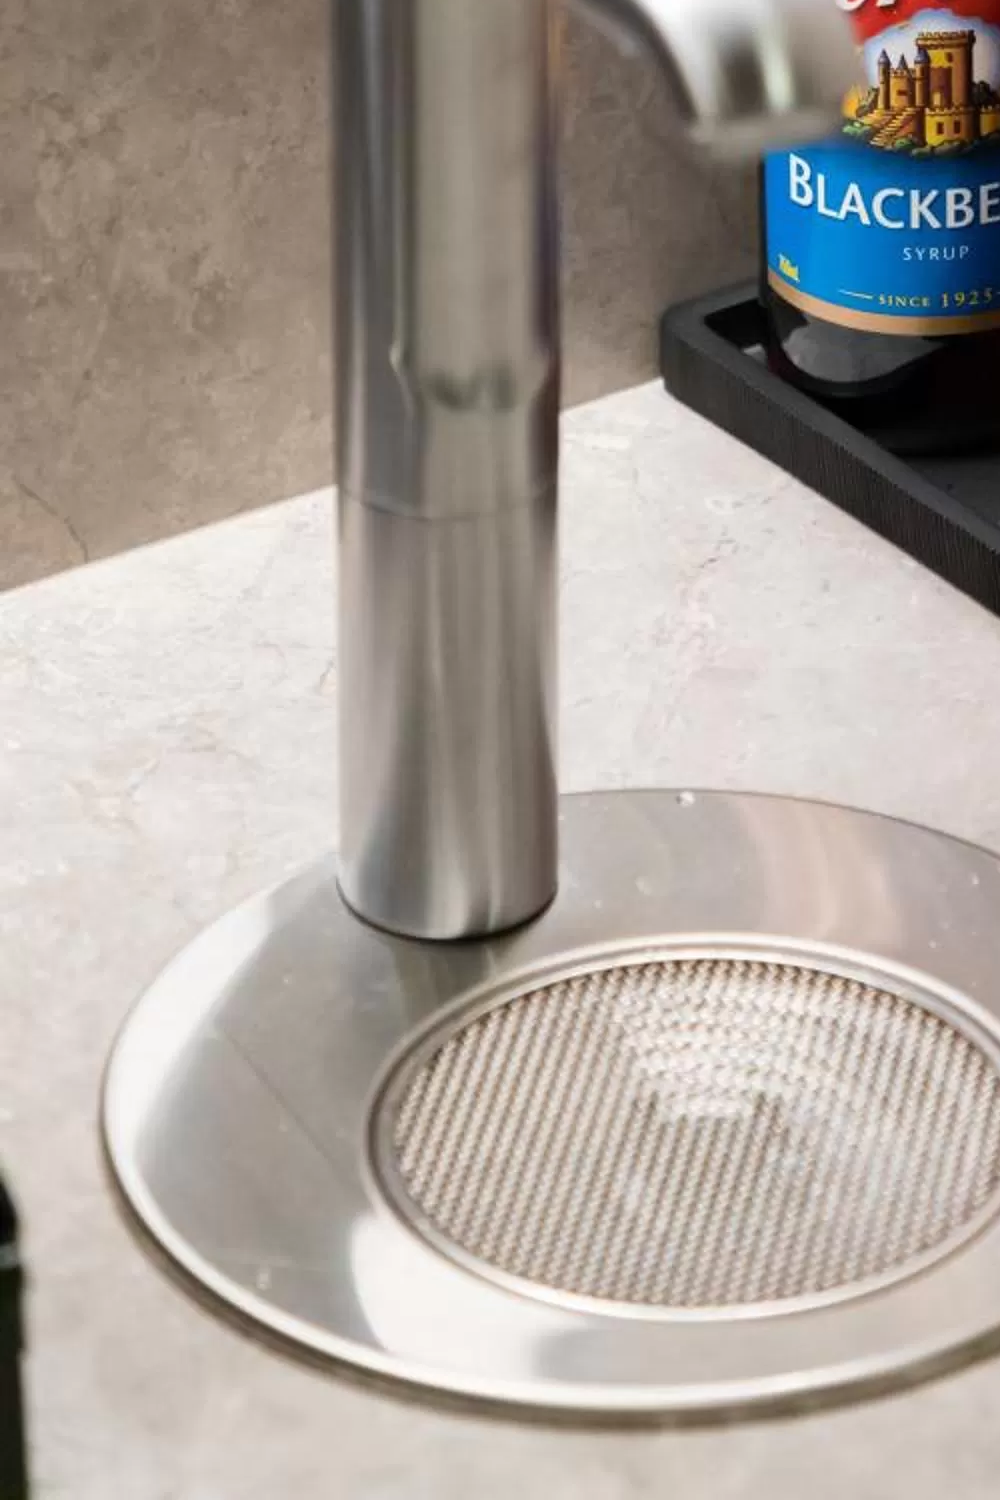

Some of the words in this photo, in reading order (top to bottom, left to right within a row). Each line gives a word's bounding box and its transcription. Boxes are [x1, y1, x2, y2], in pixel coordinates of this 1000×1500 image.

[903, 245, 970, 262] SYRUP
[878, 294, 931, 308] SINCE
[941, 290, 994, 309] 1925
